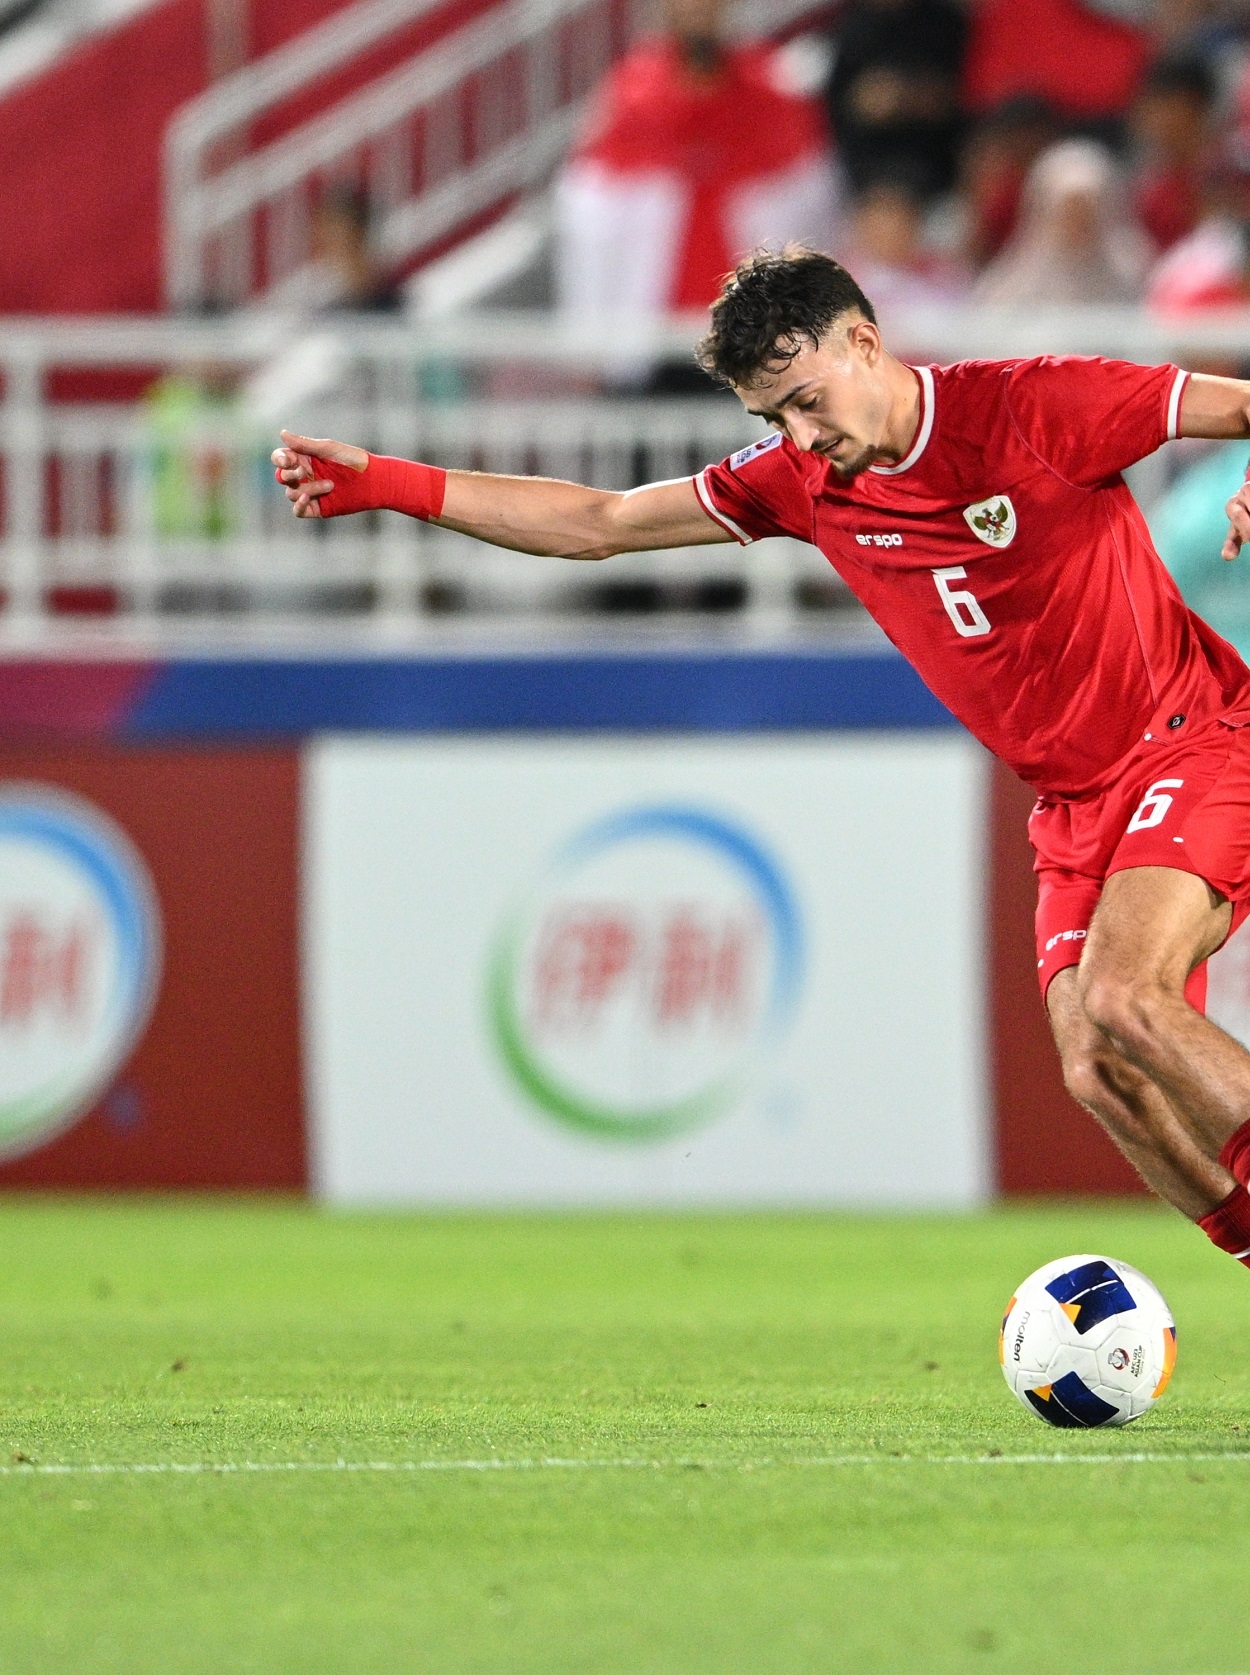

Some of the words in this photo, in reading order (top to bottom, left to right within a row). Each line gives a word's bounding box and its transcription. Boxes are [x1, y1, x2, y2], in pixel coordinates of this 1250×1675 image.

[856, 533, 903, 548] erspo
[931, 566, 991, 637] 6
[1127, 779, 1184, 834] 6
[1045, 929, 1087, 951] ersp
[1013, 1311, 1031, 1363] molten
